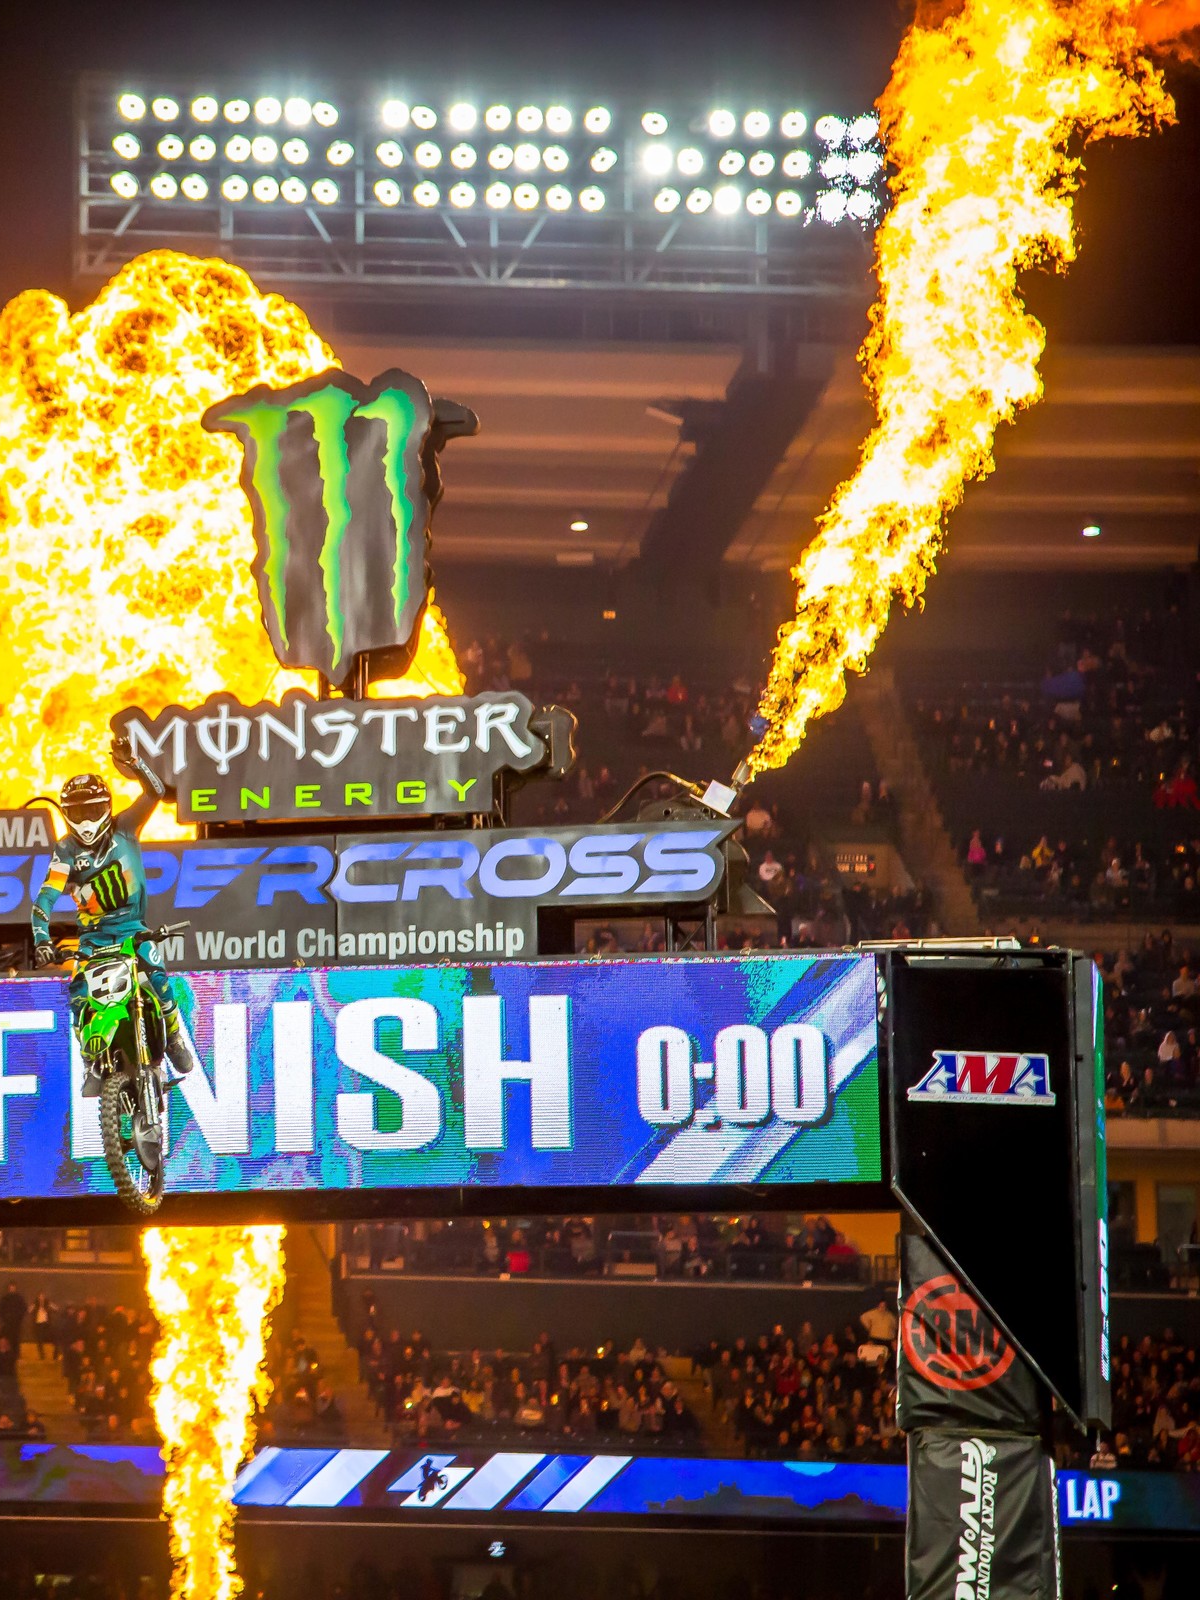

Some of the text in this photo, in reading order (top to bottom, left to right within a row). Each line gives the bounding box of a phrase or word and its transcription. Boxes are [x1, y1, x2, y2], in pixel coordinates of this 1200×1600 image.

[123, 700, 532, 776] MONSTER
[191, 778, 478, 812] ENERGY
[195, 929, 286, 961] World
[296, 922, 525, 960] Championship
[91, 963, 128, 999] 3
[636, 1023, 827, 1125] 0:00
[908, 1050, 1054, 1097] AMA
[981, 1467, 998, 1530] ROCKY
[1066, 1478, 1121, 1519] LAP
